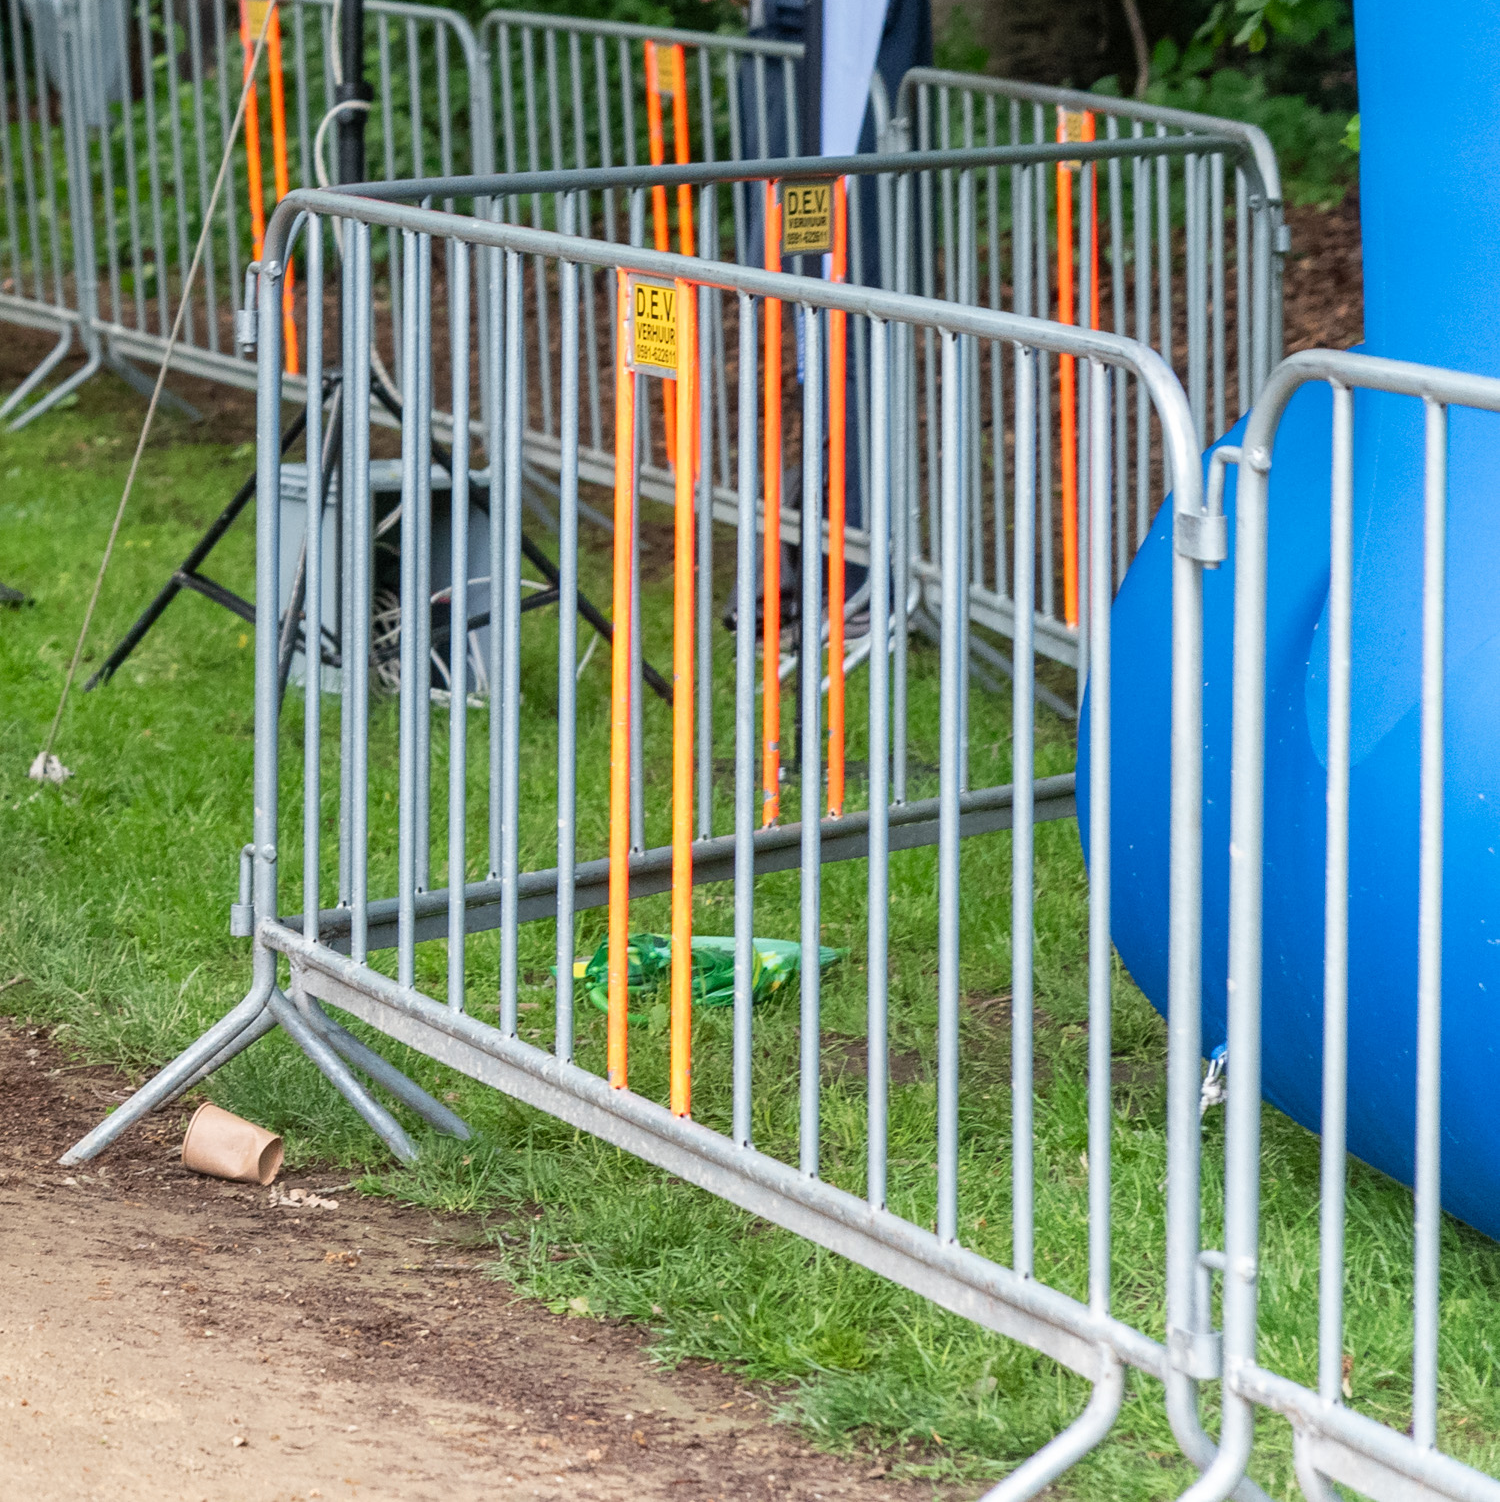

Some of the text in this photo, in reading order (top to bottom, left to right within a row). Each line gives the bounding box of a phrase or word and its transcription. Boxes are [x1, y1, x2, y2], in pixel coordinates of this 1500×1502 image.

[788, 189, 828, 215] D.E.V.
[636, 288, 675, 323] D.E.V.
[636, 322, 675, 345] VERHUUR
